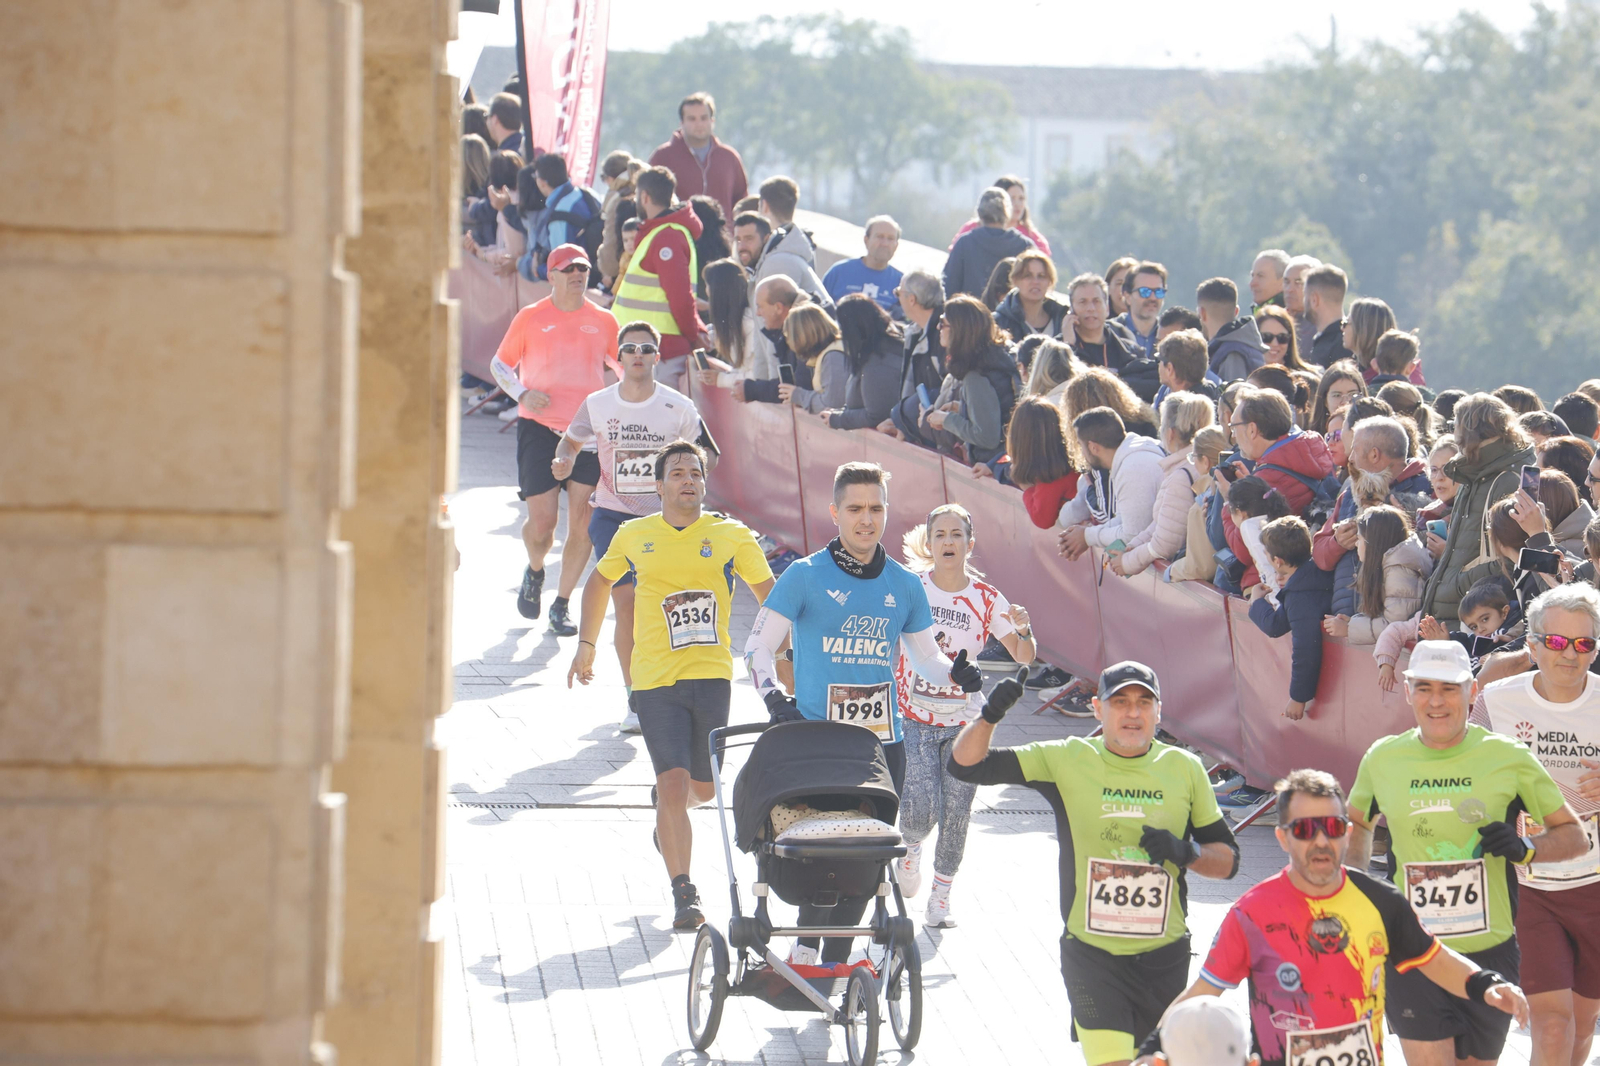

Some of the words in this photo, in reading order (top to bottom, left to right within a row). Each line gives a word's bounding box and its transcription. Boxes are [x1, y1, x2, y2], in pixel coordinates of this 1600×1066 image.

[576, 88, 596, 178] Municipal
[621, 424, 649, 433] MEDIA
[608, 432, 619, 440] 37
[621, 432, 666, 442] MARATÓN
[617, 463, 656, 477] 442
[671, 607, 711, 627] 2536
[930, 606, 971, 624] UERRERAS
[841, 614, 890, 639] 42K
[838, 701, 883, 720] 1998
[1537, 731, 1579, 743] MEDIA
[1410, 777, 1472, 788] RANING
[1102, 787, 1163, 800] RANING
[1101, 803, 1143, 812] CLUB
[1409, 798, 1451, 808] CLUB
[1094, 883, 1162, 908] 4863
[1414, 883, 1478, 908] 3476
